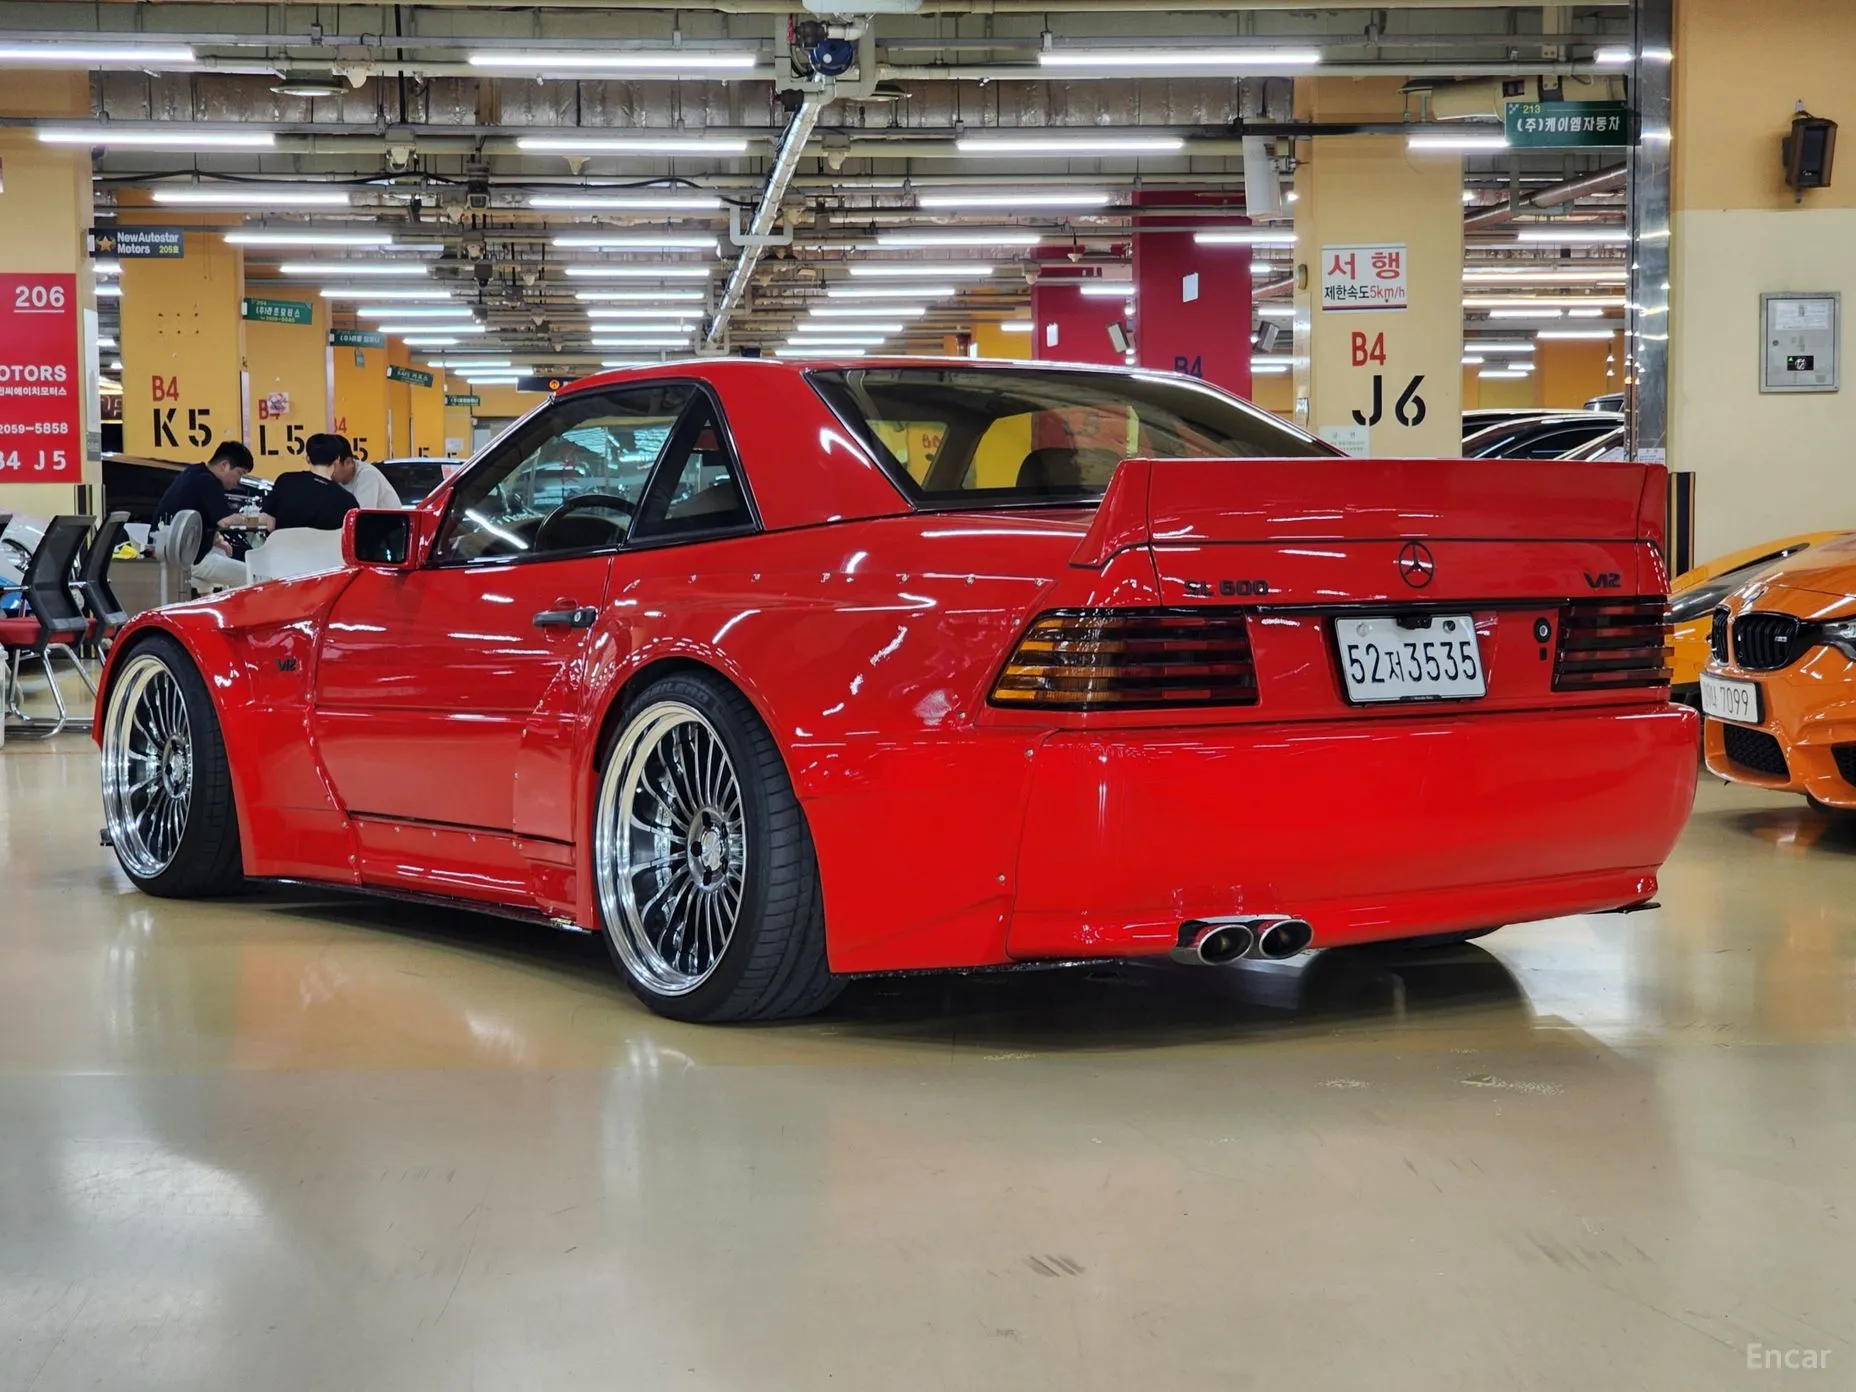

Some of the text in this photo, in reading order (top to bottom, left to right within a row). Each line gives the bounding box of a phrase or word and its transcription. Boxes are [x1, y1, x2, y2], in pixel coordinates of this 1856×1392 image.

[1522, 104, 1541, 114] 213
[117, 243, 151, 254] Motors
[15, 286, 65, 307] 206
[1351, 331, 1387, 367] B4
[151, 375, 180, 402] B4
[1184, 578, 1268, 597] SL 600
[1583, 571, 1622, 589] V12
[1347, 640, 1477, 684] 52저3535
[1719, 686, 1749, 716] 7099
